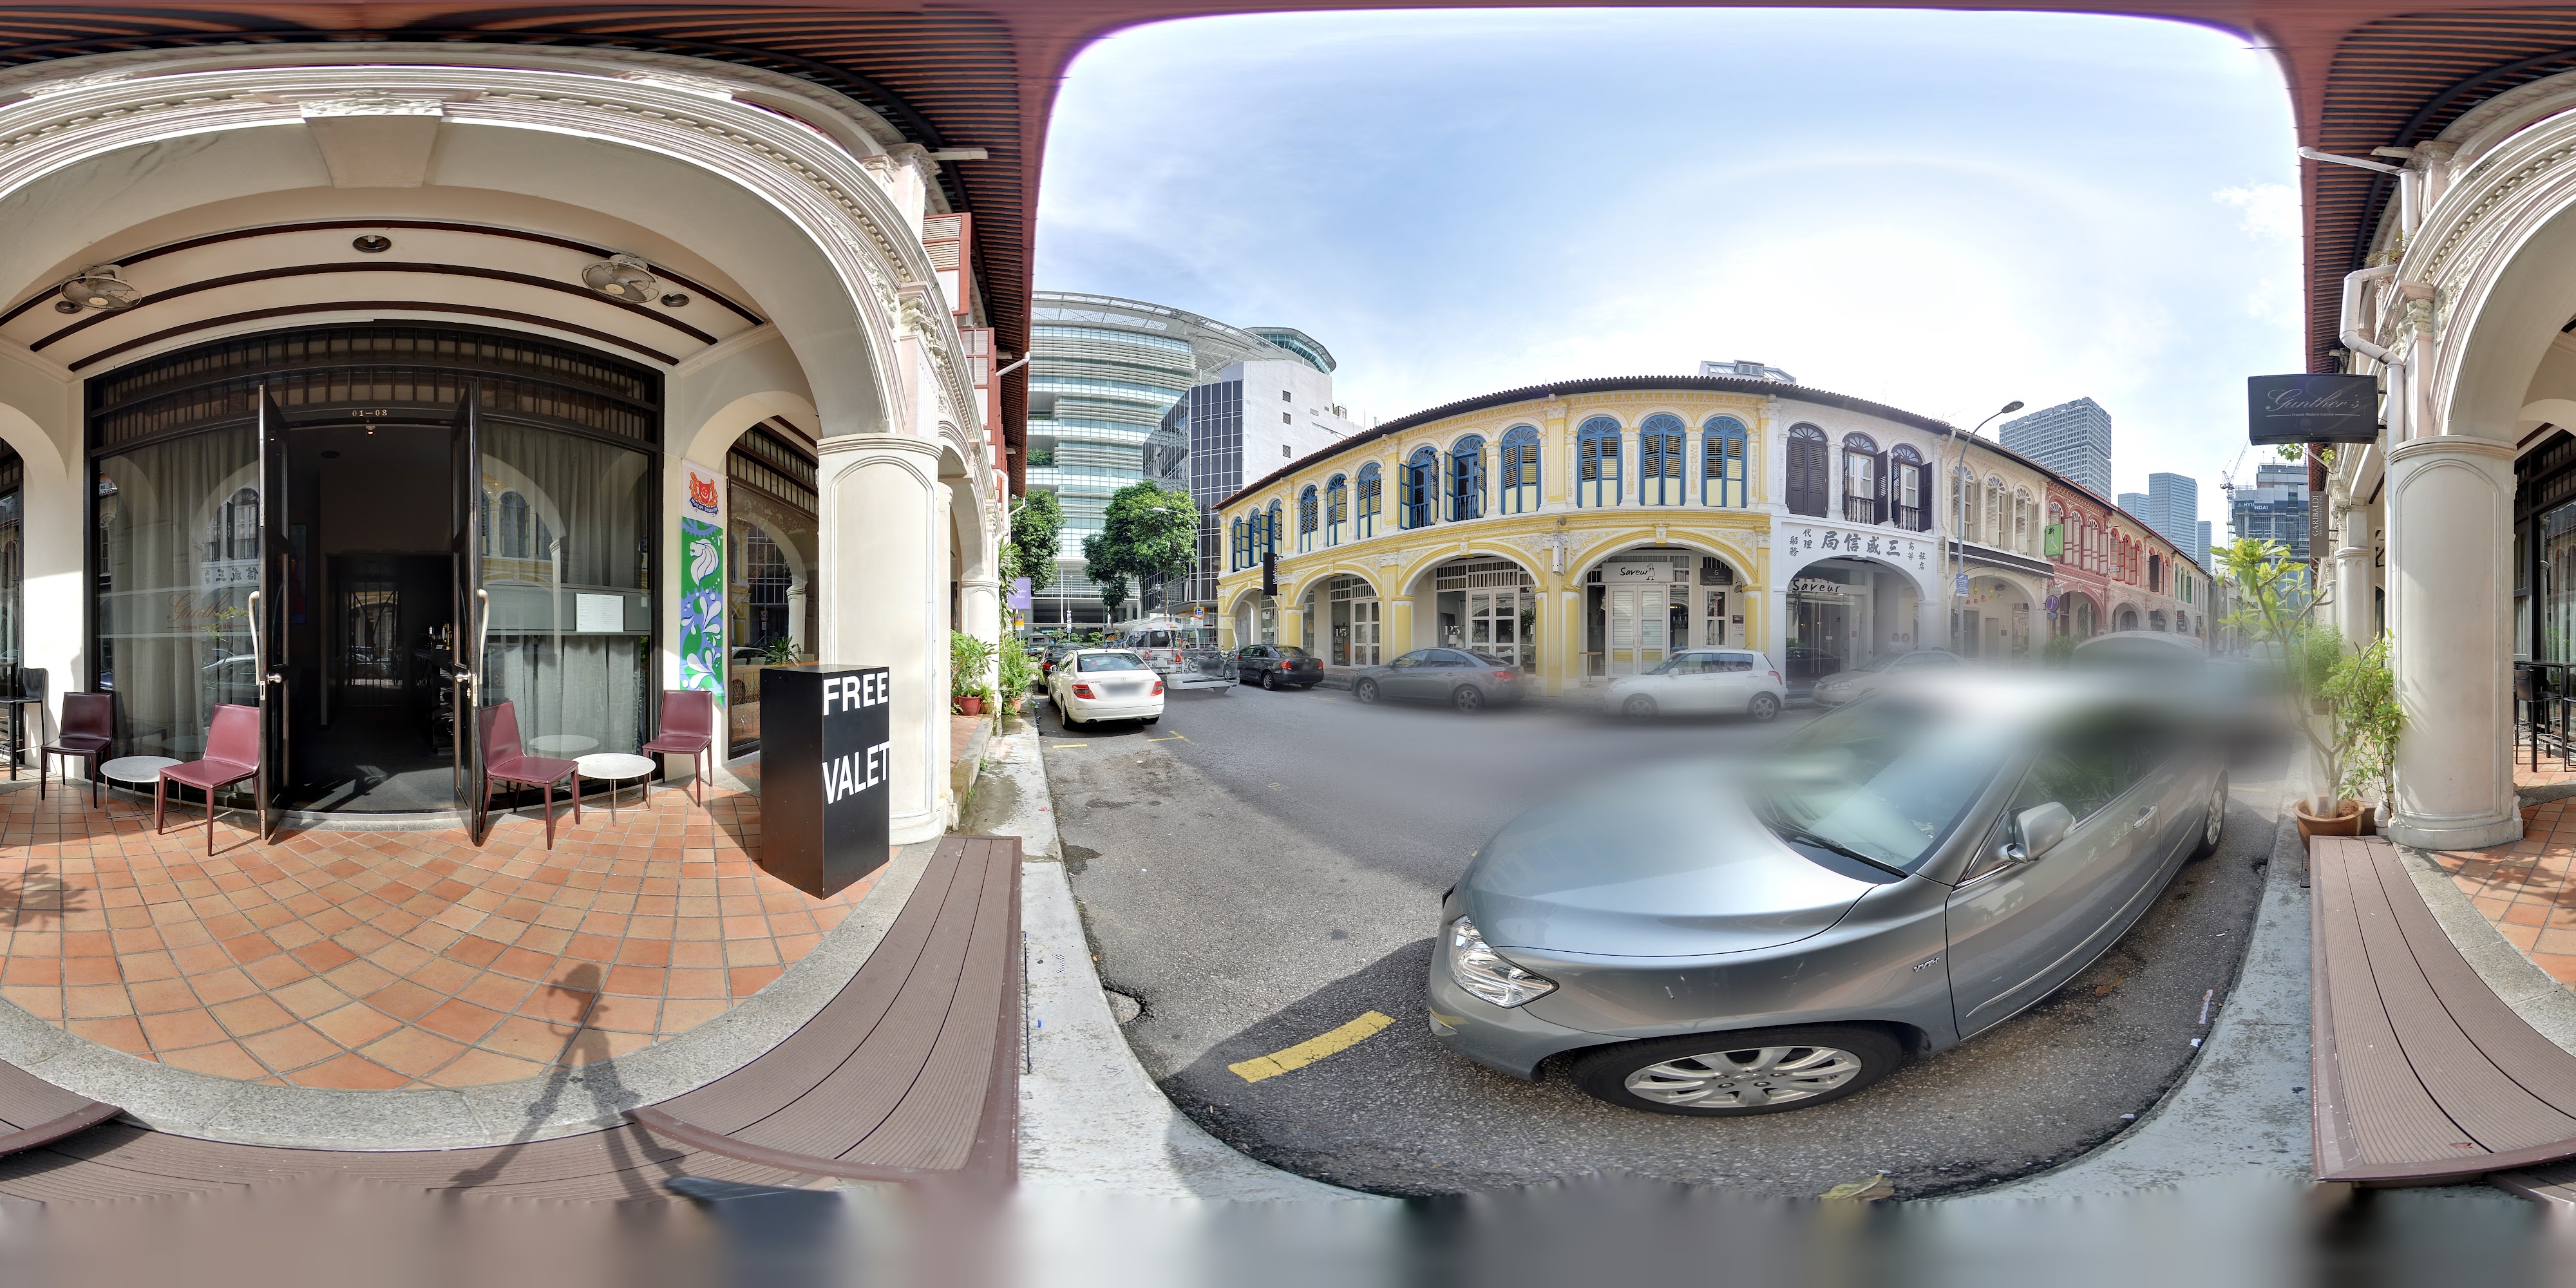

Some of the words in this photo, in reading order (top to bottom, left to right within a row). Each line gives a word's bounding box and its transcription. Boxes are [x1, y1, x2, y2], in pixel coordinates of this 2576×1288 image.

[2266, 388, 2360, 412] Gunther's
[1620, 567, 1649, 576] Saveur
[1792, 579, 1841, 592] Saveur
[167, 592, 248, 621] Gunthe'
[823, 672, 888, 716] FREE
[822, 741, 890, 804] VALET
